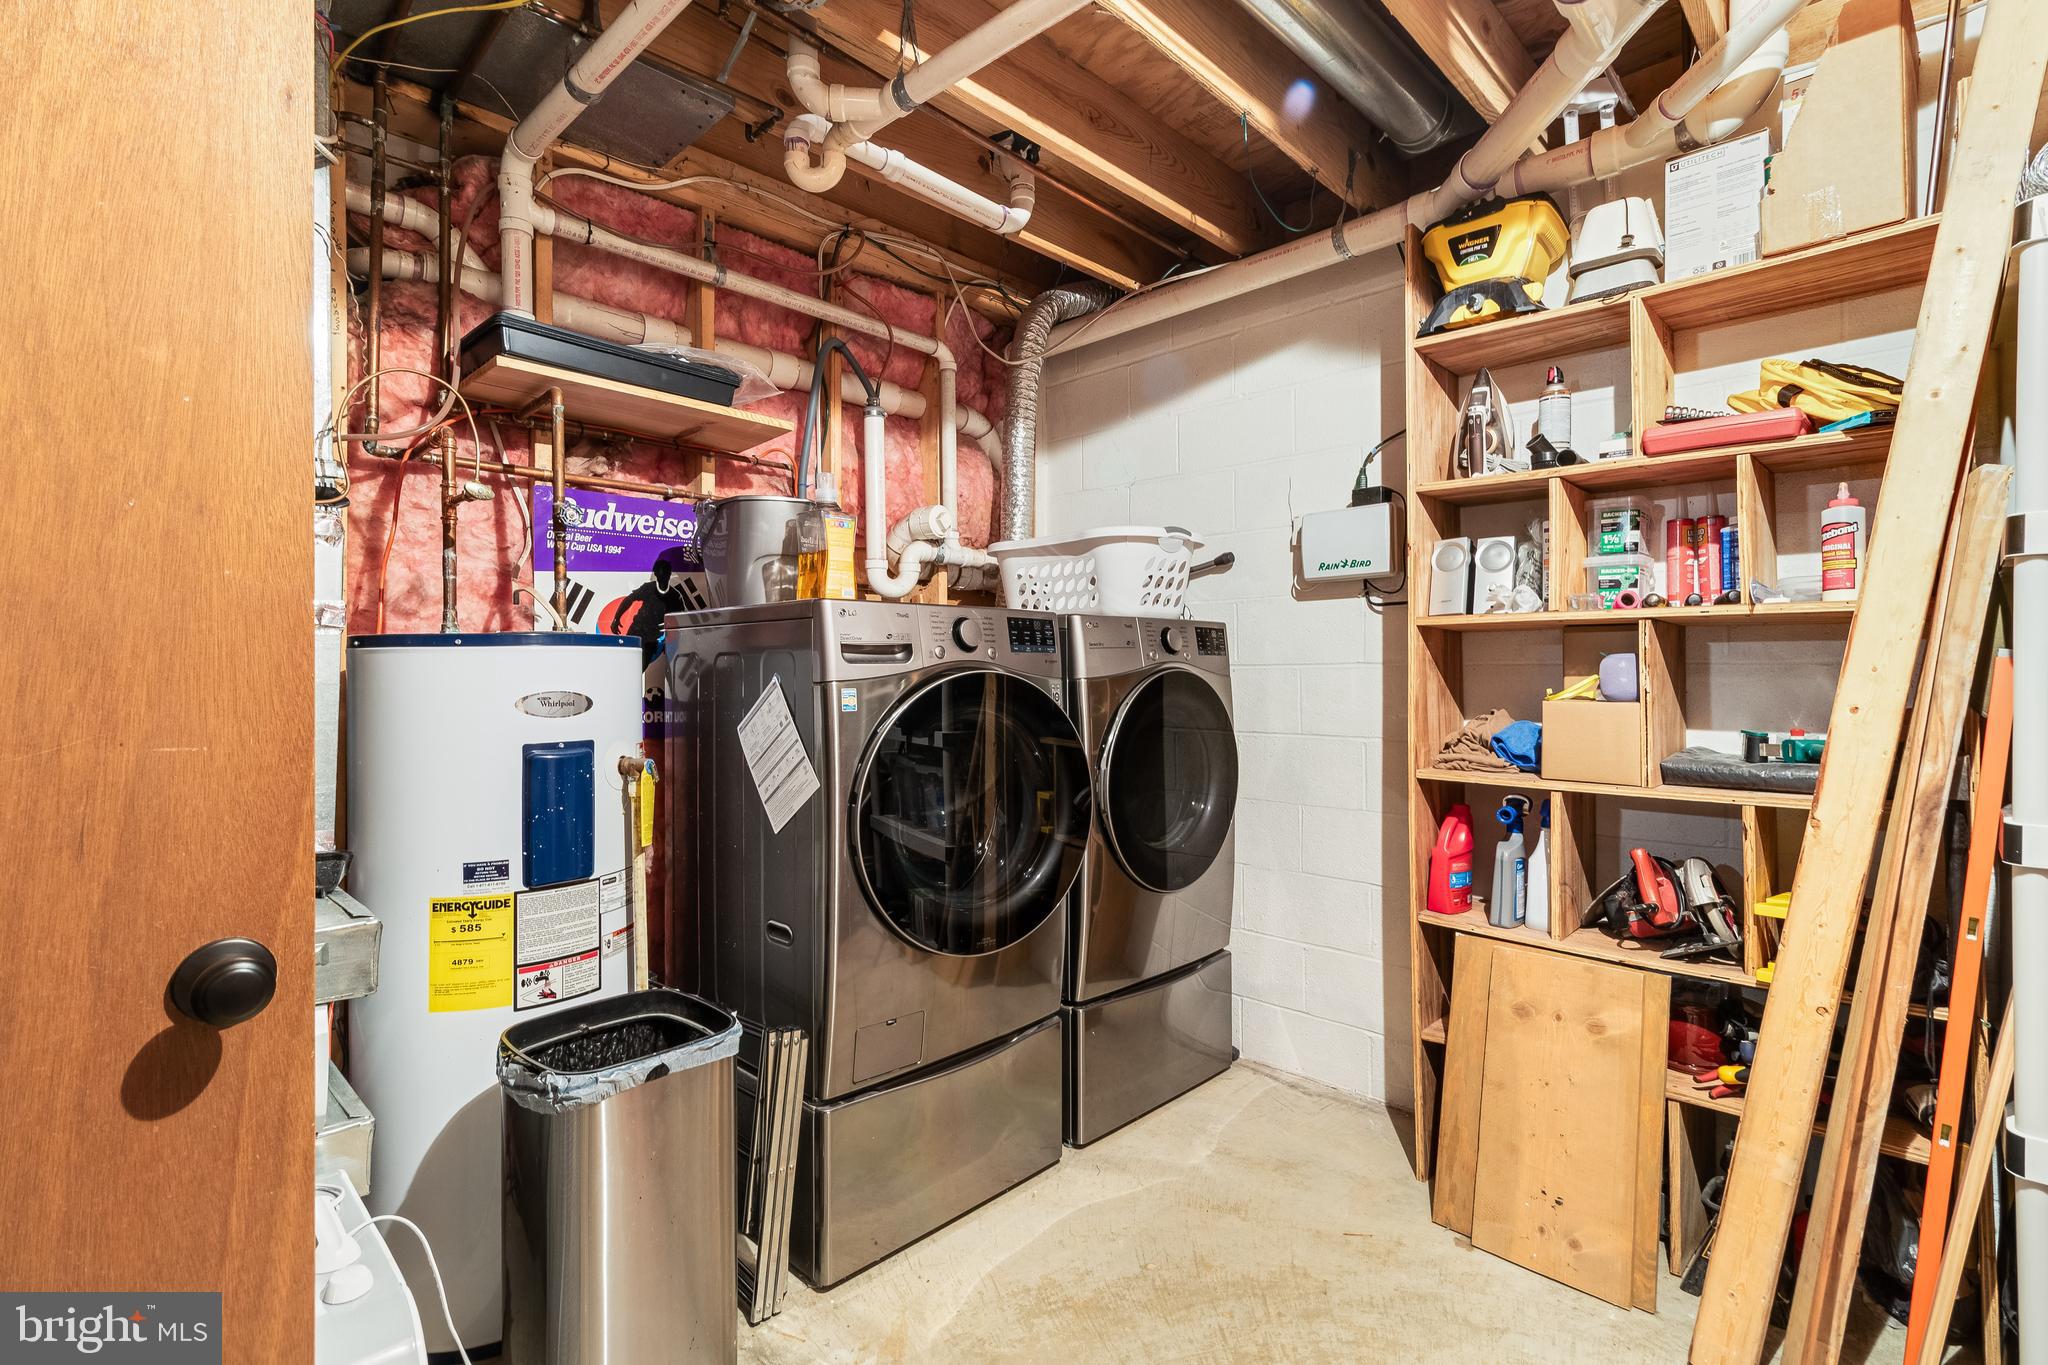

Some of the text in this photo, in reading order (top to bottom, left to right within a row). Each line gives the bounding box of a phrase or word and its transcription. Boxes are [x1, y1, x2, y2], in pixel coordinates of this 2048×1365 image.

[1680, 149, 1724, 168] UTILITECH
[1458, 236, 1490, 250] WAGNER
[575, 533, 592, 543] Beer
[570, 542, 586, 553] Cup
[586, 544, 603, 553] USA
[540, 699, 575, 708] Whirlpool
[432, 898, 511, 915] ENERGYGUIDE
[459, 923, 482, 933] 585
[451, 958, 474, 966] 4879
